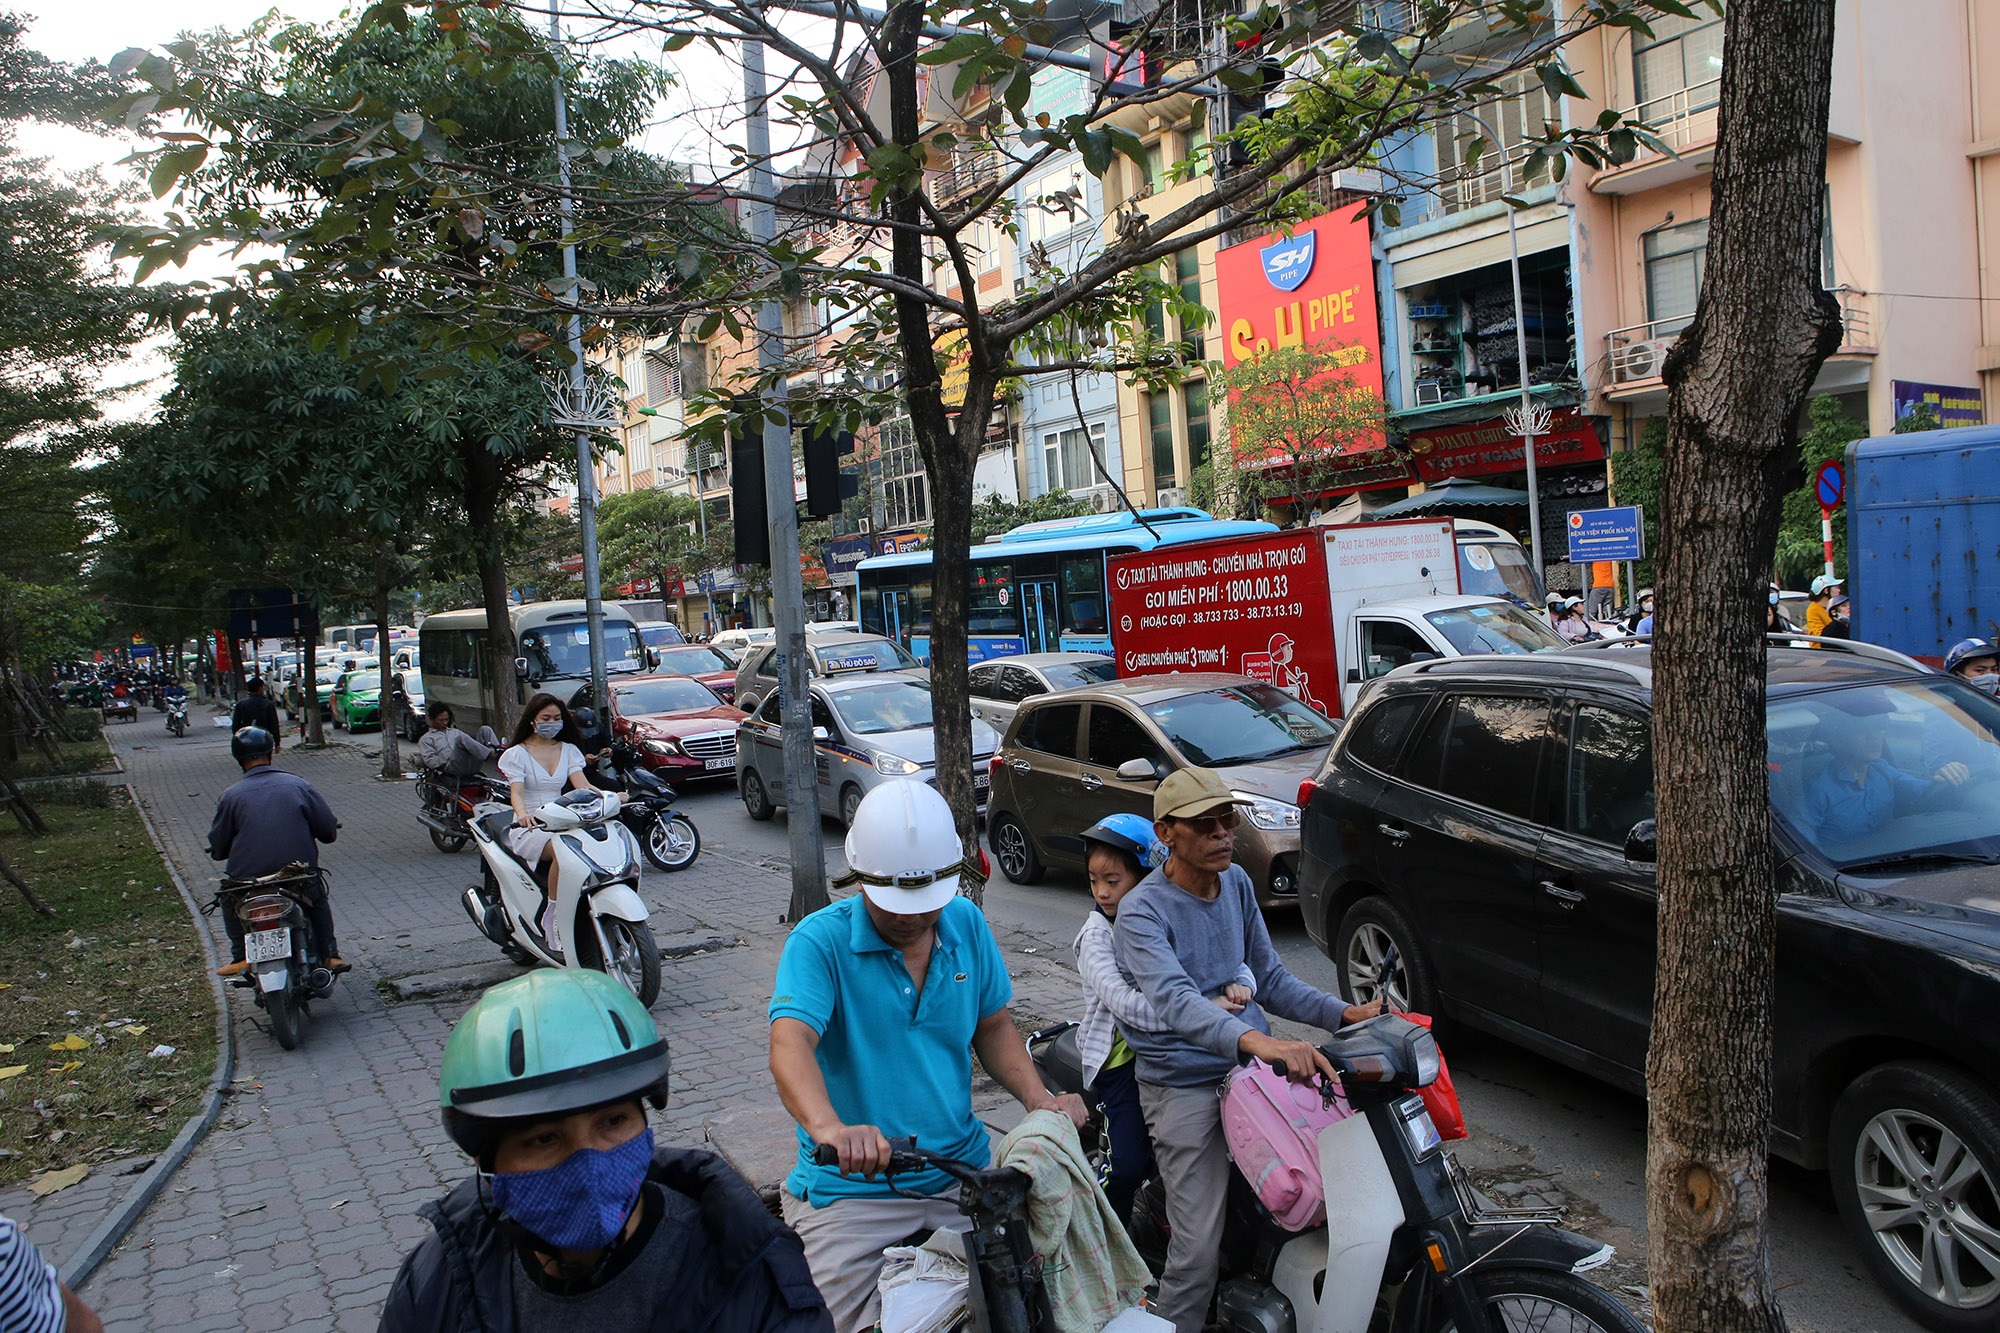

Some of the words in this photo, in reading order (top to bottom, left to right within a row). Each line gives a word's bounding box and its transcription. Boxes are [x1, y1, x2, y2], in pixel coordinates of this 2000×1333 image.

[1267, 244, 1310, 273] SH
[1280, 269, 1299, 281] PIPE
[1338, 540, 1352, 550] TAXI
[831, 549, 868, 564] Panasonic
[1130, 567, 1145, 584] TAXI
[1159, 560, 1184, 580] THÀNH
[1246, 548, 1264, 570] NHÀ
[1265, 549, 1289, 570] TRỌN
[1290, 543, 1306, 565] GÓI
[1168, 584, 1196, 607] MIỄN
[1225, 574, 1288, 603] 1800.00.33
[1140, 614, 1168, 630] (HOẶC
[1169, 612, 1186, 627] GỌI
[1193, 610, 1221, 624] 38.733
[1222, 608, 1239, 621] 733
[1247, 602, 1303, 619] 38.73.13.13)
[863, 657, 877, 666] SAO
[1174, 648, 1190, 664] PHÁT
[1190, 646, 1197, 667] 3
[1197, 649, 1219, 663] TRONG
